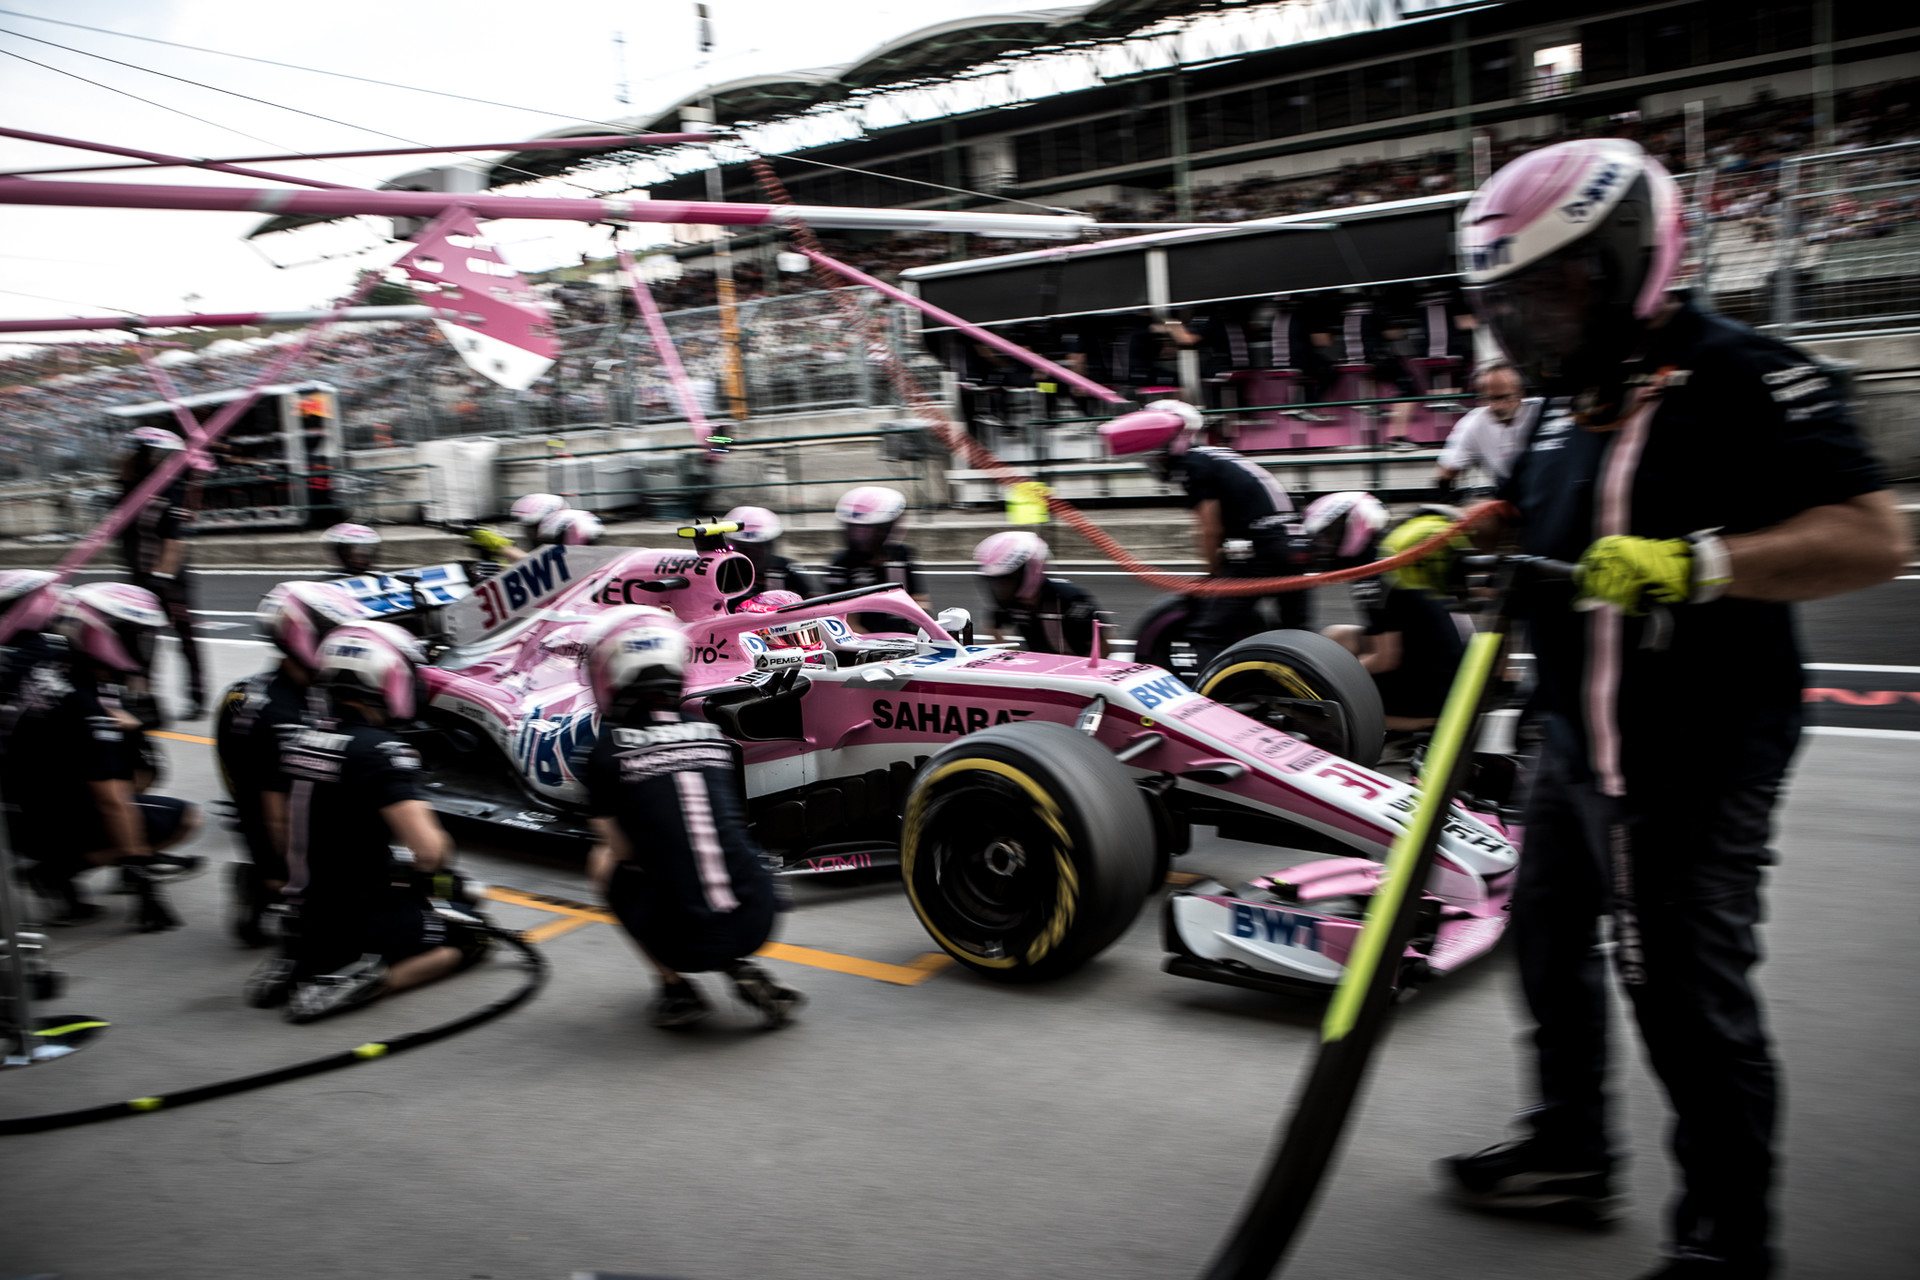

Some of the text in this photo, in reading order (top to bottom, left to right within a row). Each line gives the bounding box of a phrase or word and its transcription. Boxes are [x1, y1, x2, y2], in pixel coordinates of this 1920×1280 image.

[654, 555, 714, 576] HYPE
[474, 580, 508, 630] 31
[502, 544, 571, 611] BWT
[751, 603, 770, 613] NEC
[769, 655, 803, 666] PEMEX
[1314, 762, 1394, 801] 31
[1229, 902, 1325, 954] BWT
